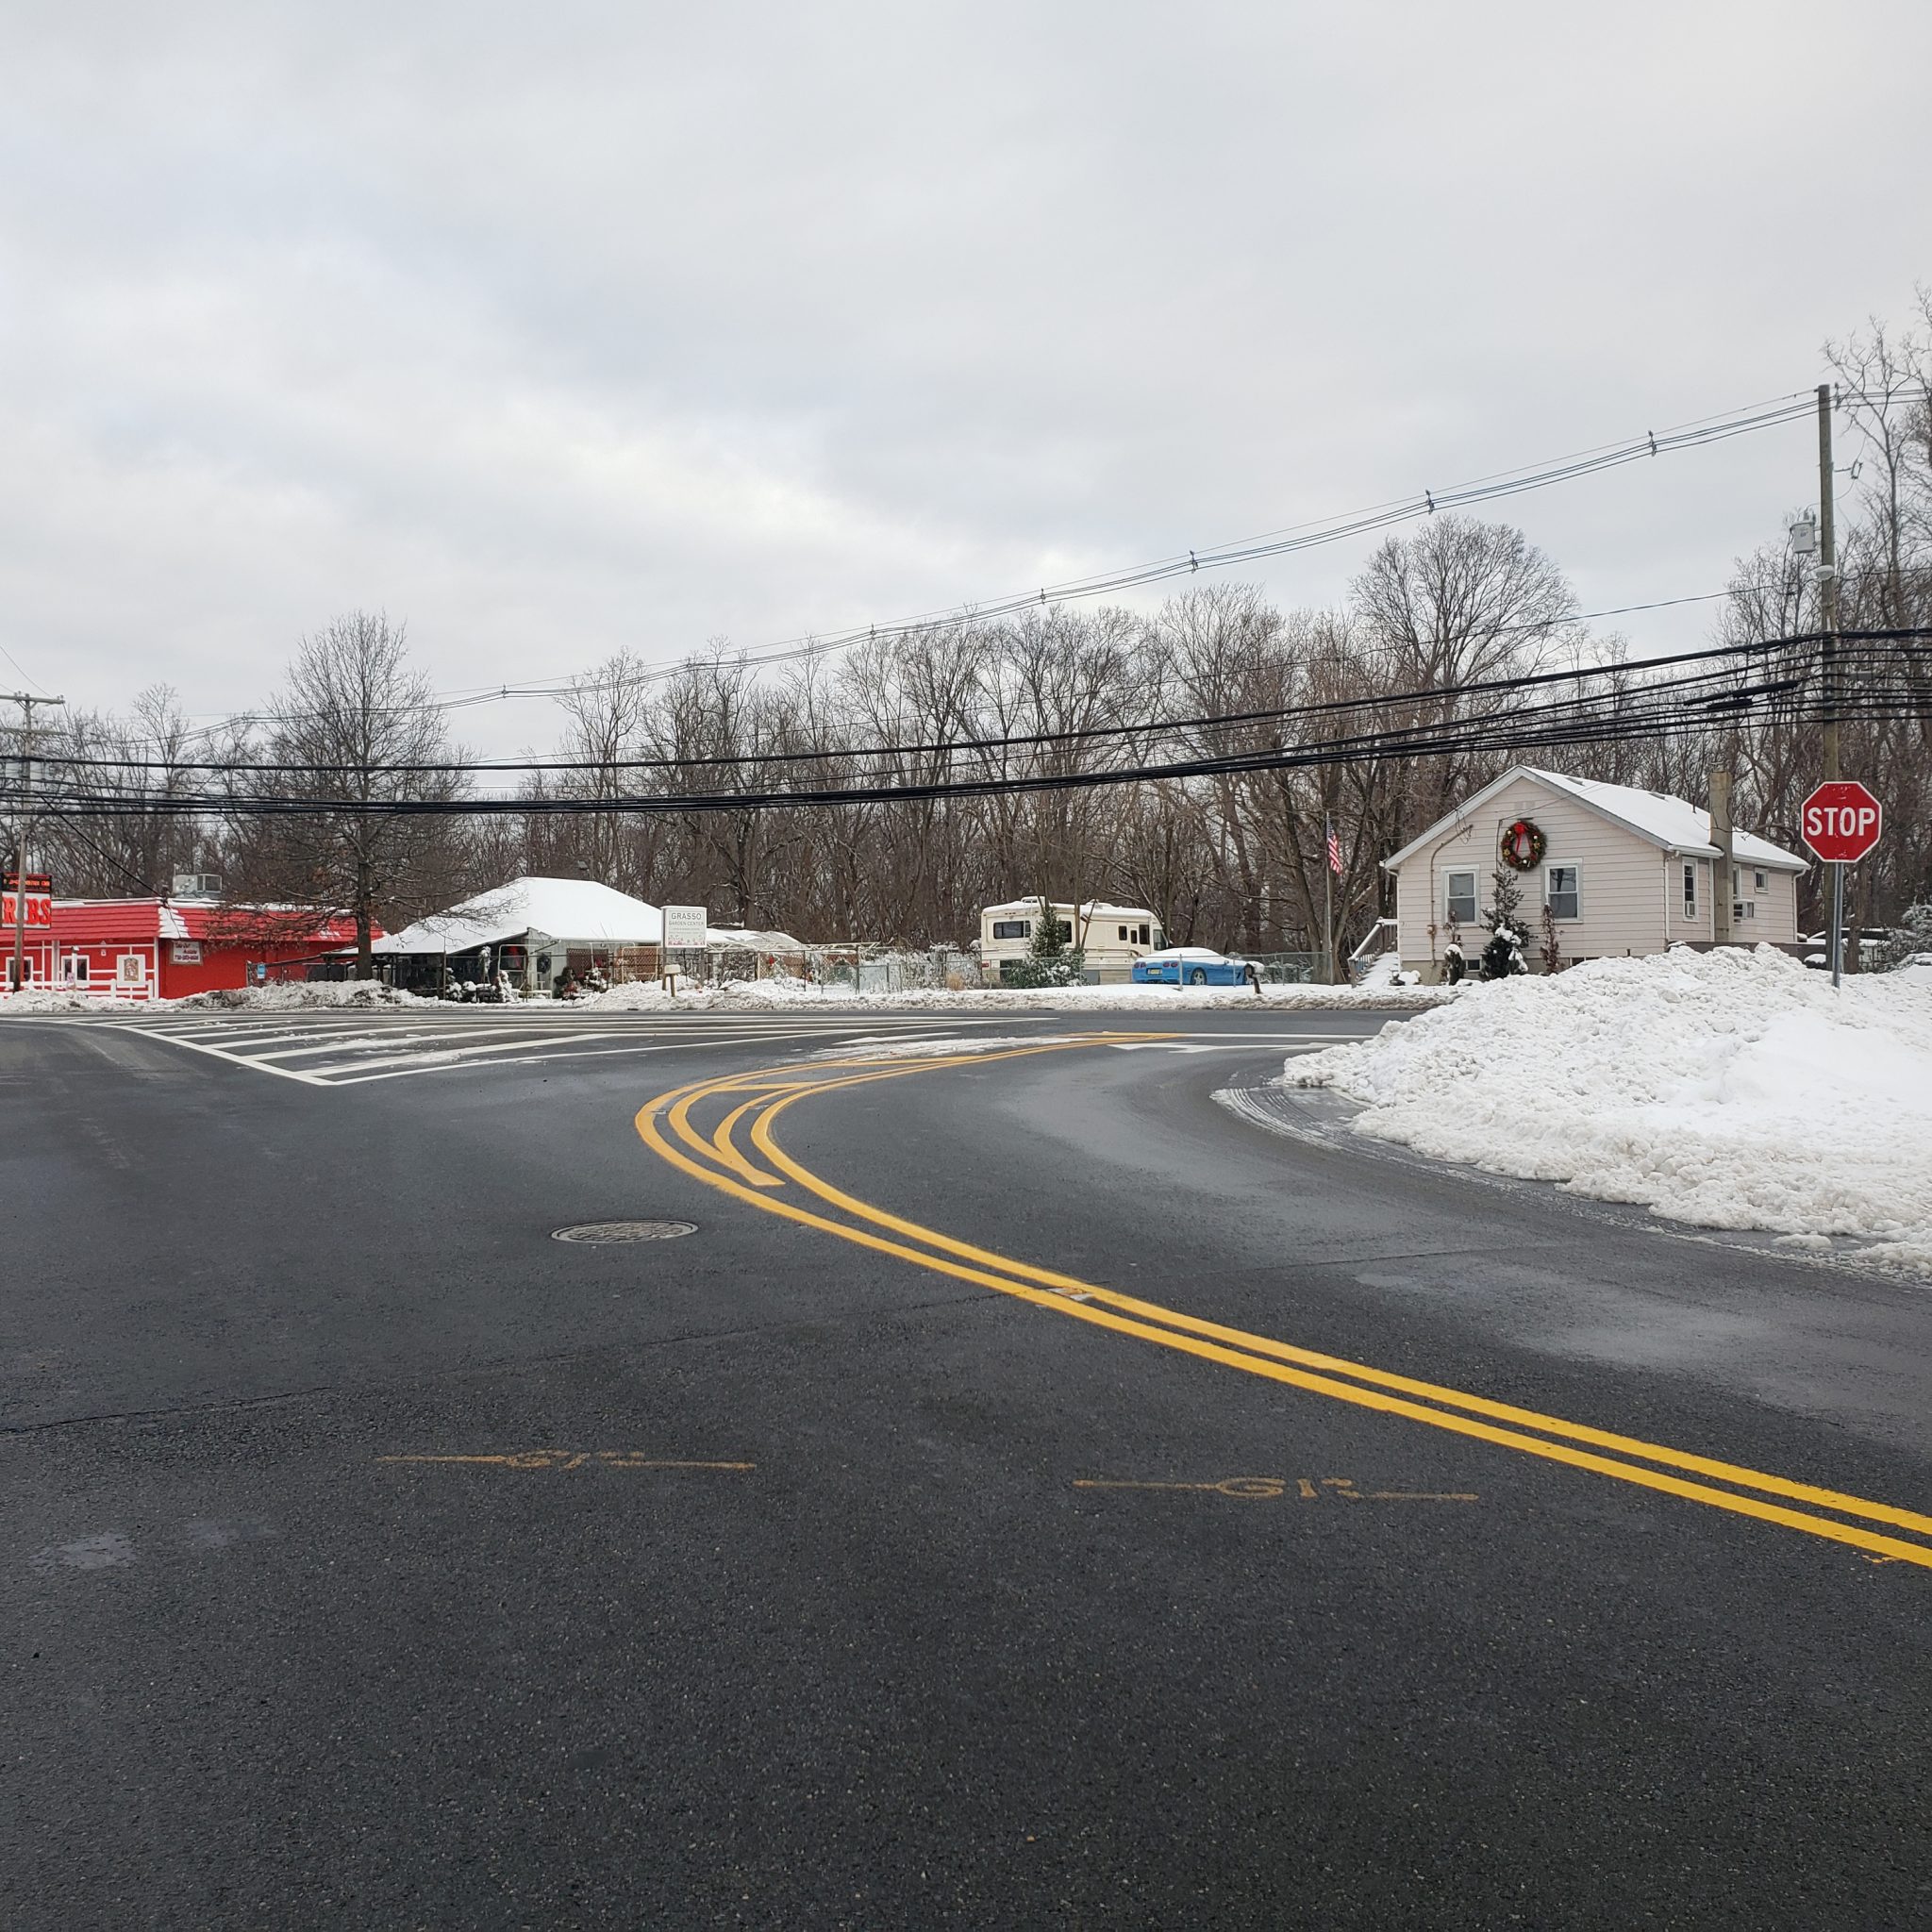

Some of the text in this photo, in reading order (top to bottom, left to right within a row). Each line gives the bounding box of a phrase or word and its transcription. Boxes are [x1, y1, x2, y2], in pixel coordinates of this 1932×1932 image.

[1807, 807, 1876, 837] STOP
[2, 897, 52, 925] RBS
[671, 912, 702, 921] GRASSO
